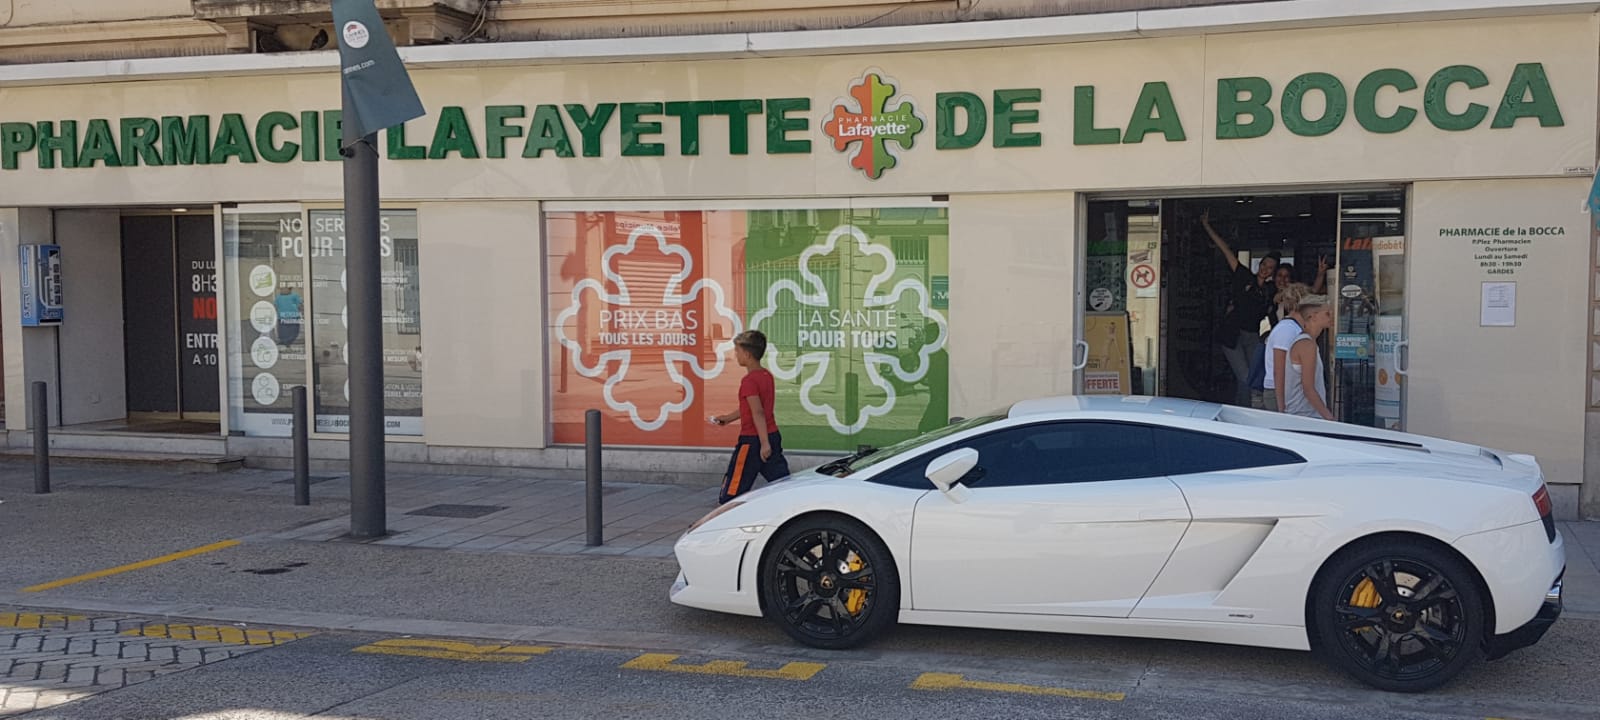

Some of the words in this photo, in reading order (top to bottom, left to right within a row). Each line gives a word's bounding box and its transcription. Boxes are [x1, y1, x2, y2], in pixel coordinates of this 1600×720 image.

[1, 110, 345, 170] PHARMACIE
[386, 98, 811, 160] LAFAYETTE
[935, 88, 1042, 150] DE
[1073, 81, 1187, 146] LA
[1215, 62, 1565, 140] BOCCA
[838, 114, 908, 123] PHARMACIE
[838, 122, 907, 137] Lafayette
[280, 218, 304, 233] NO
[316, 217, 390, 233] SERS
[1439, 228, 1500, 237] PHARMACIE
[1502, 227, 1515, 236] de
[1517, 227, 1527, 236] la
[1529, 226, 1565, 236] BOCCA
[338, 235, 391, 257] TS
[192, 261, 205, 269] DU
[192, 274, 217, 292] 8H3
[193, 297, 217, 319] NO
[600, 310, 648, 329] PRIX
[656, 310, 698, 329] BAS
[799, 310, 823, 327] LA
[830, 305, 897, 327] SANTÉ
[186, 333, 218, 348] ENTR
[600, 333, 628, 345] TOUS
[632, 333, 653, 345] LES
[657, 333, 697, 346] JOURS
[798, 330, 845, 348] POUR
[851, 330, 897, 348] TOUS
[192, 353, 202, 365] A
[204, 353, 217, 365] 10
[1086, 378, 1119, 390] FFERTE
